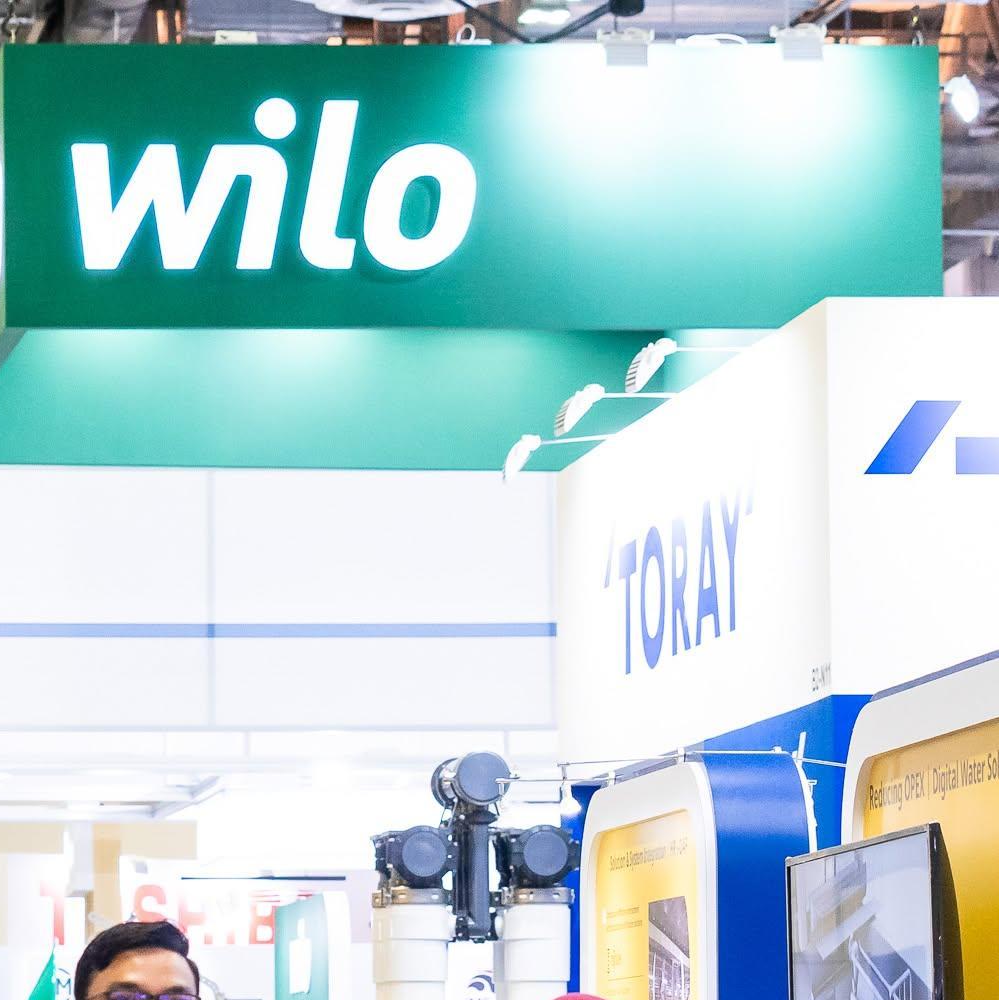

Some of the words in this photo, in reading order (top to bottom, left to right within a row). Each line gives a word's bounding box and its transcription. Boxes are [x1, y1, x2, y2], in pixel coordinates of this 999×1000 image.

[71, 97, 477, 271] wilo
[618, 490, 741, 674] TORAY
[869, 781, 903, 811] Reducing
[904, 771, 925, 801] OPEX
[932, 761, 959, 800] Digital
[960, 758, 985, 786] Water
